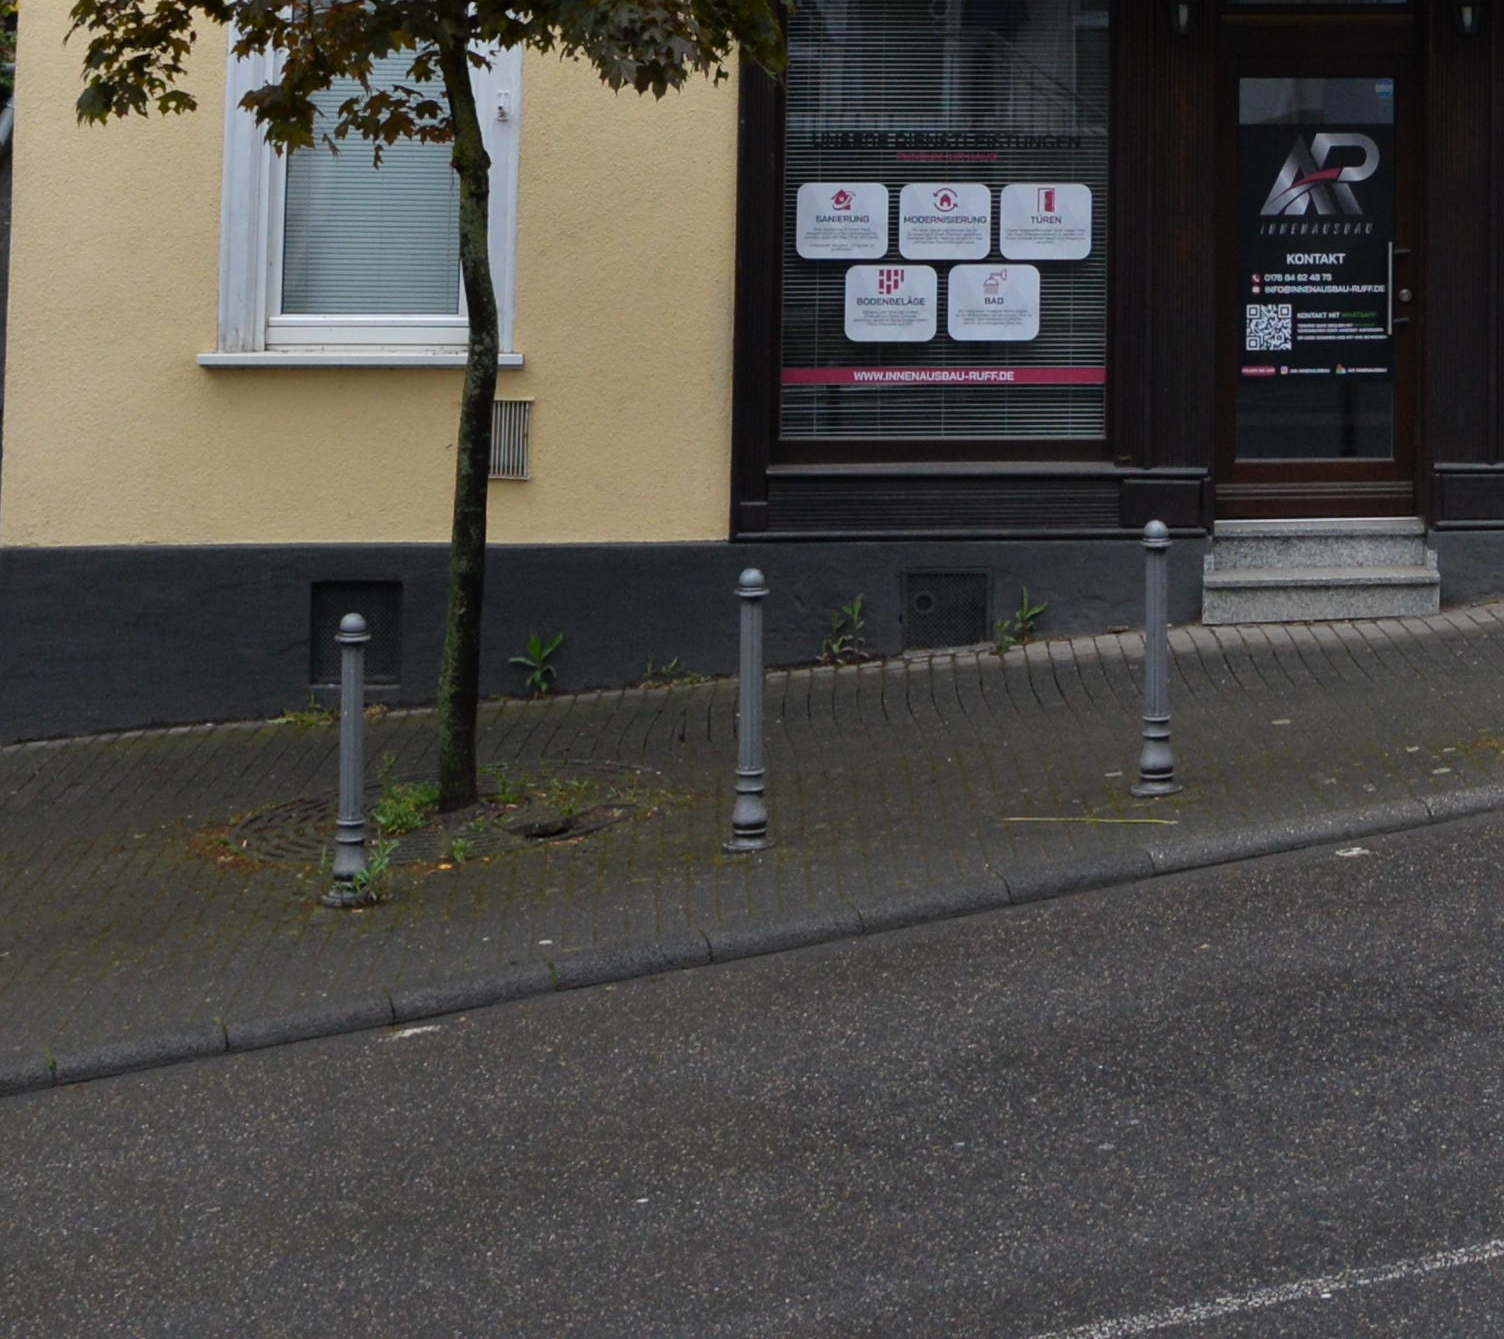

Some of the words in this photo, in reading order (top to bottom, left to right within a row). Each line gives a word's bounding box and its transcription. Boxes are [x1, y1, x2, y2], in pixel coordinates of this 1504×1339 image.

[815, 214, 870, 224] SANIERUNG
[903, 214, 988, 225] MODERNISIERUNG
[1029, 213, 1063, 224] TÜREN
[1259, 222, 1374, 235] INNENAUSBAU
[1285, 252, 1347, 266] KONTAKT
[856, 296, 926, 307] BODENBELÄGE
[984, 296, 1005, 305] BAD
[853, 369, 1015, 383] WWW.INNENAUSBAU-RUFF.DE
